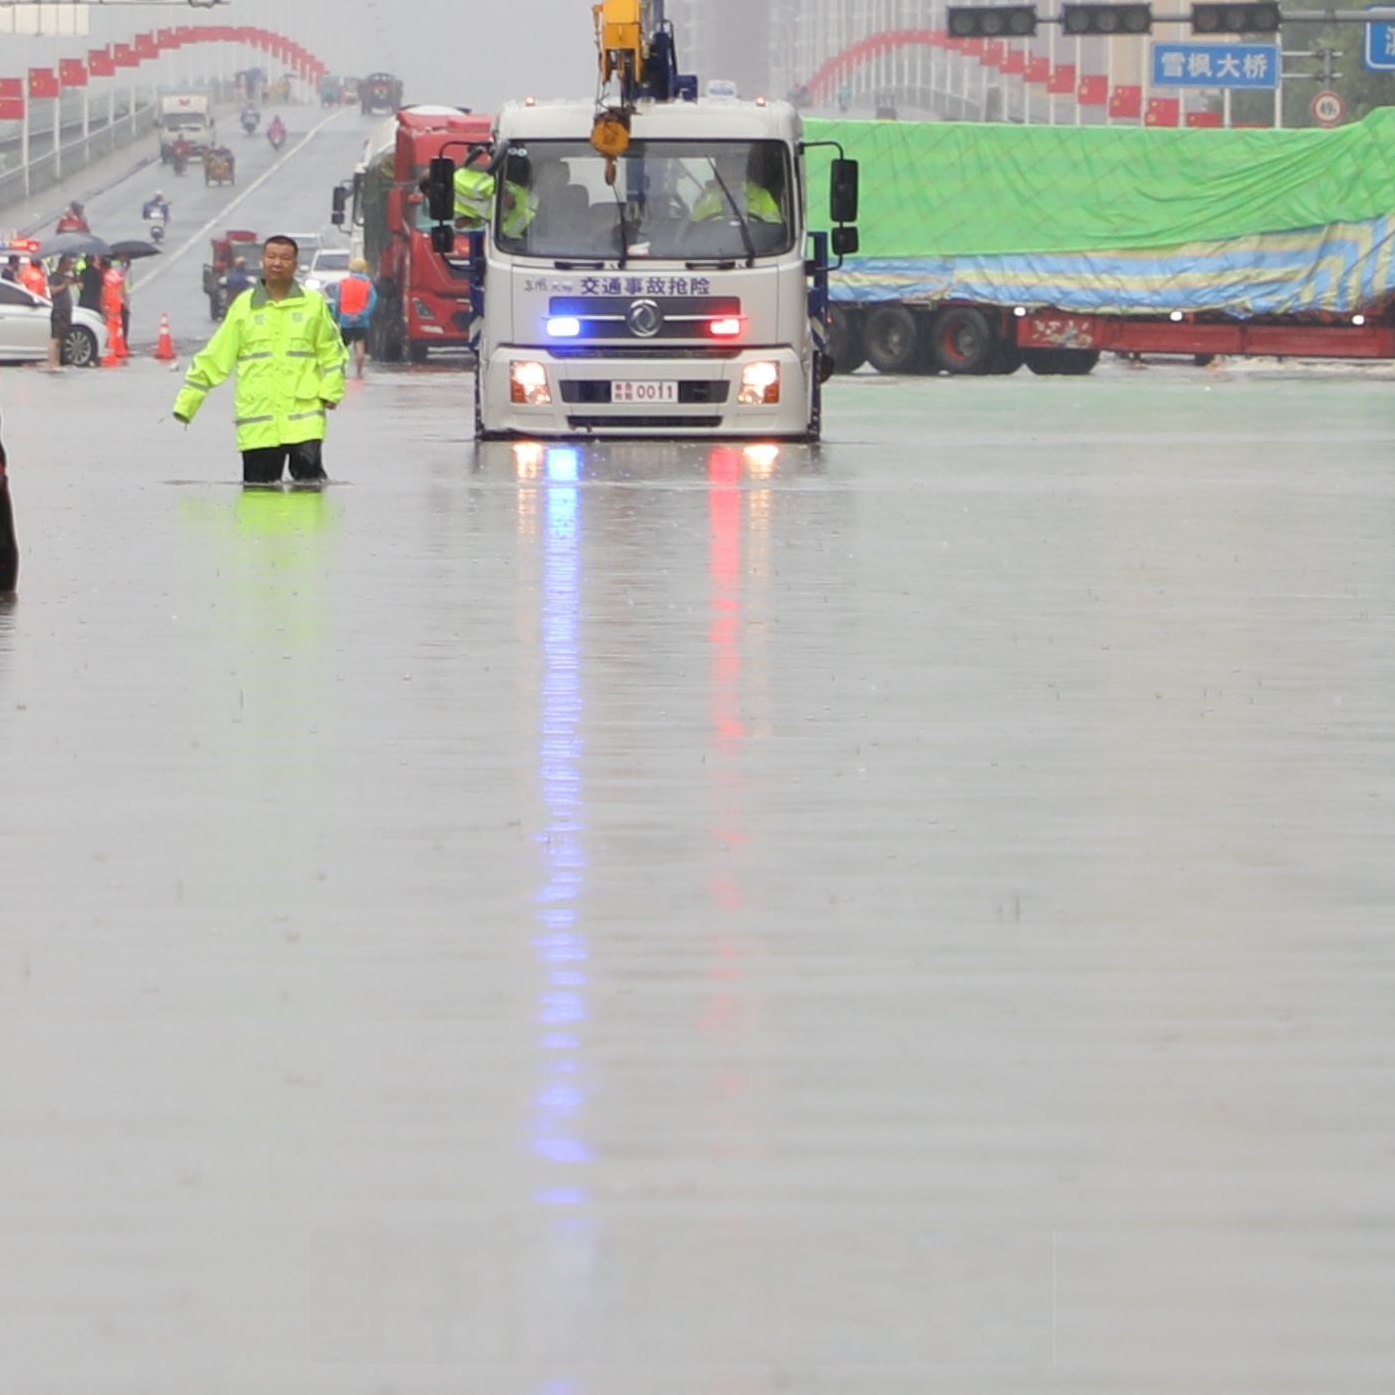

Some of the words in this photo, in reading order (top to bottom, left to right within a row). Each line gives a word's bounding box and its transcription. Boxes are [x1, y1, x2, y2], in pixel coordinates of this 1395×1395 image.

[1161, 52, 1267, 79] 雪枫大桥
[580, 276, 711, 296] 交通事故抢险
[637, 383, 673, 400] 0011
